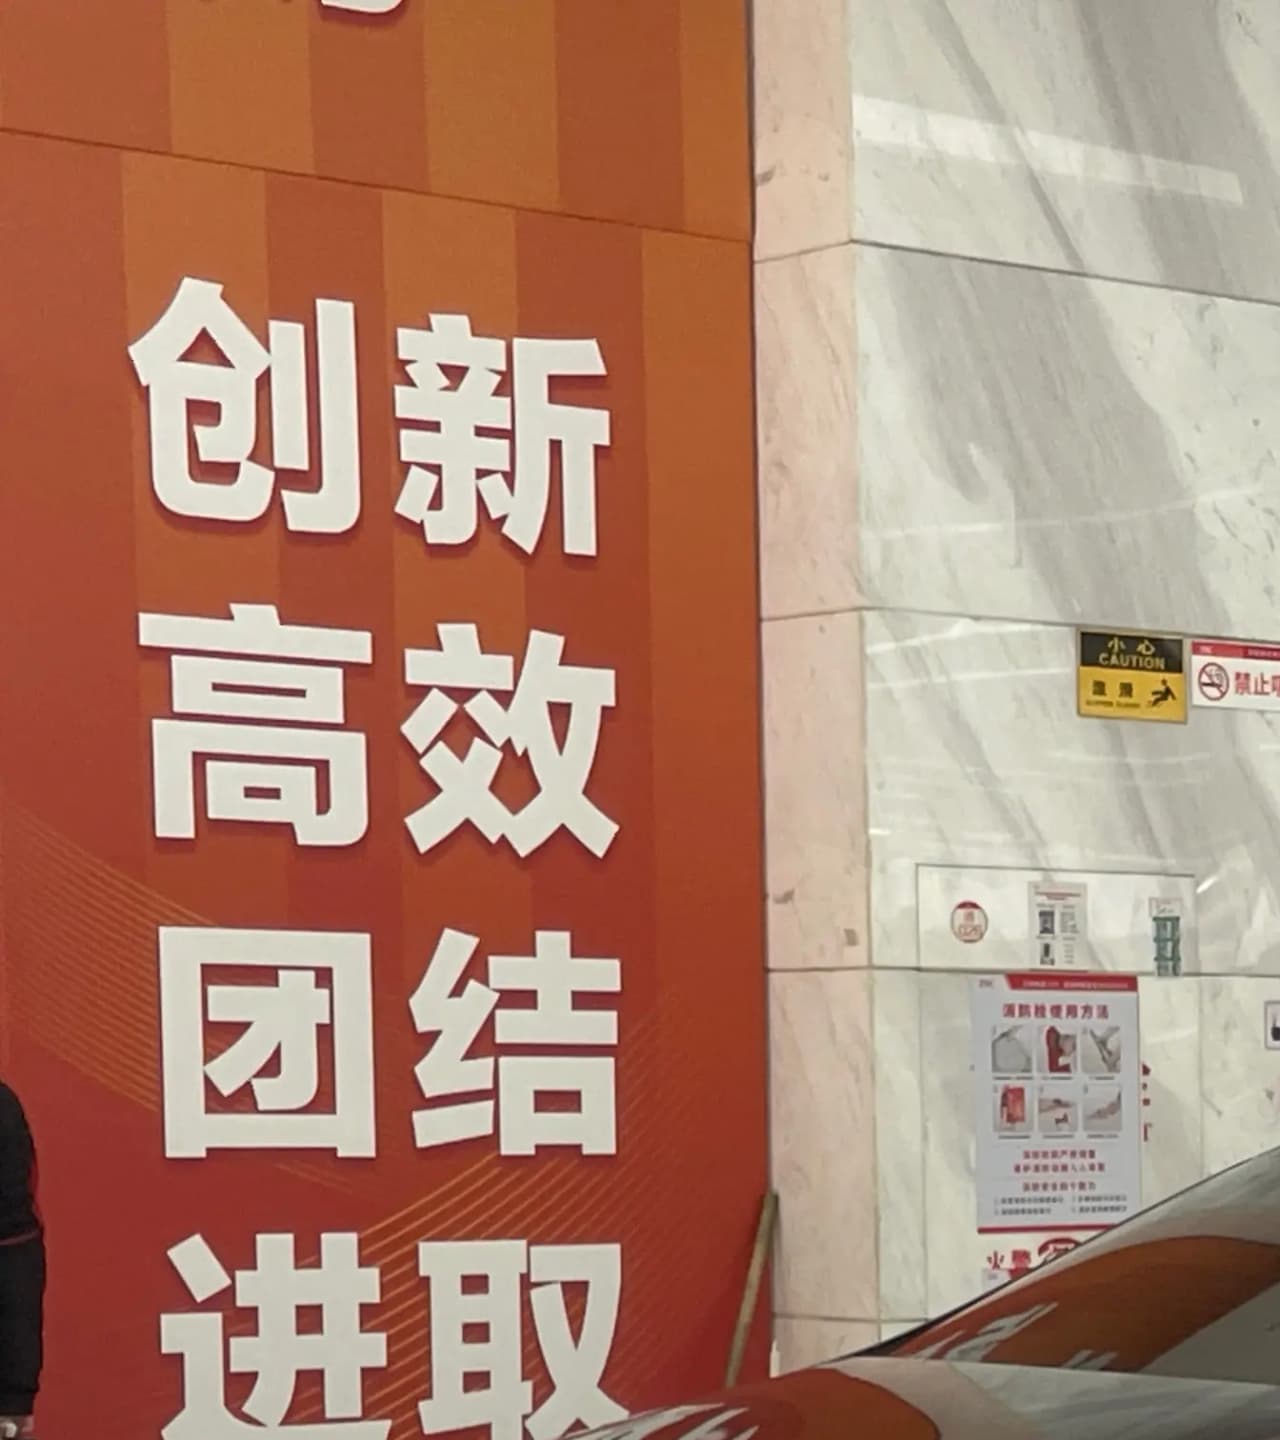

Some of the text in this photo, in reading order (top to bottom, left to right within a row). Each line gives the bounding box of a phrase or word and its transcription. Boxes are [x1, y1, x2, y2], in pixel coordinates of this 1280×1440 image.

[128, 277, 610, 556] 创新
[138, 603, 620, 858] 高效
[1099, 652, 1166, 670] CAUTION
[159, 926, 622, 1158] 团结
